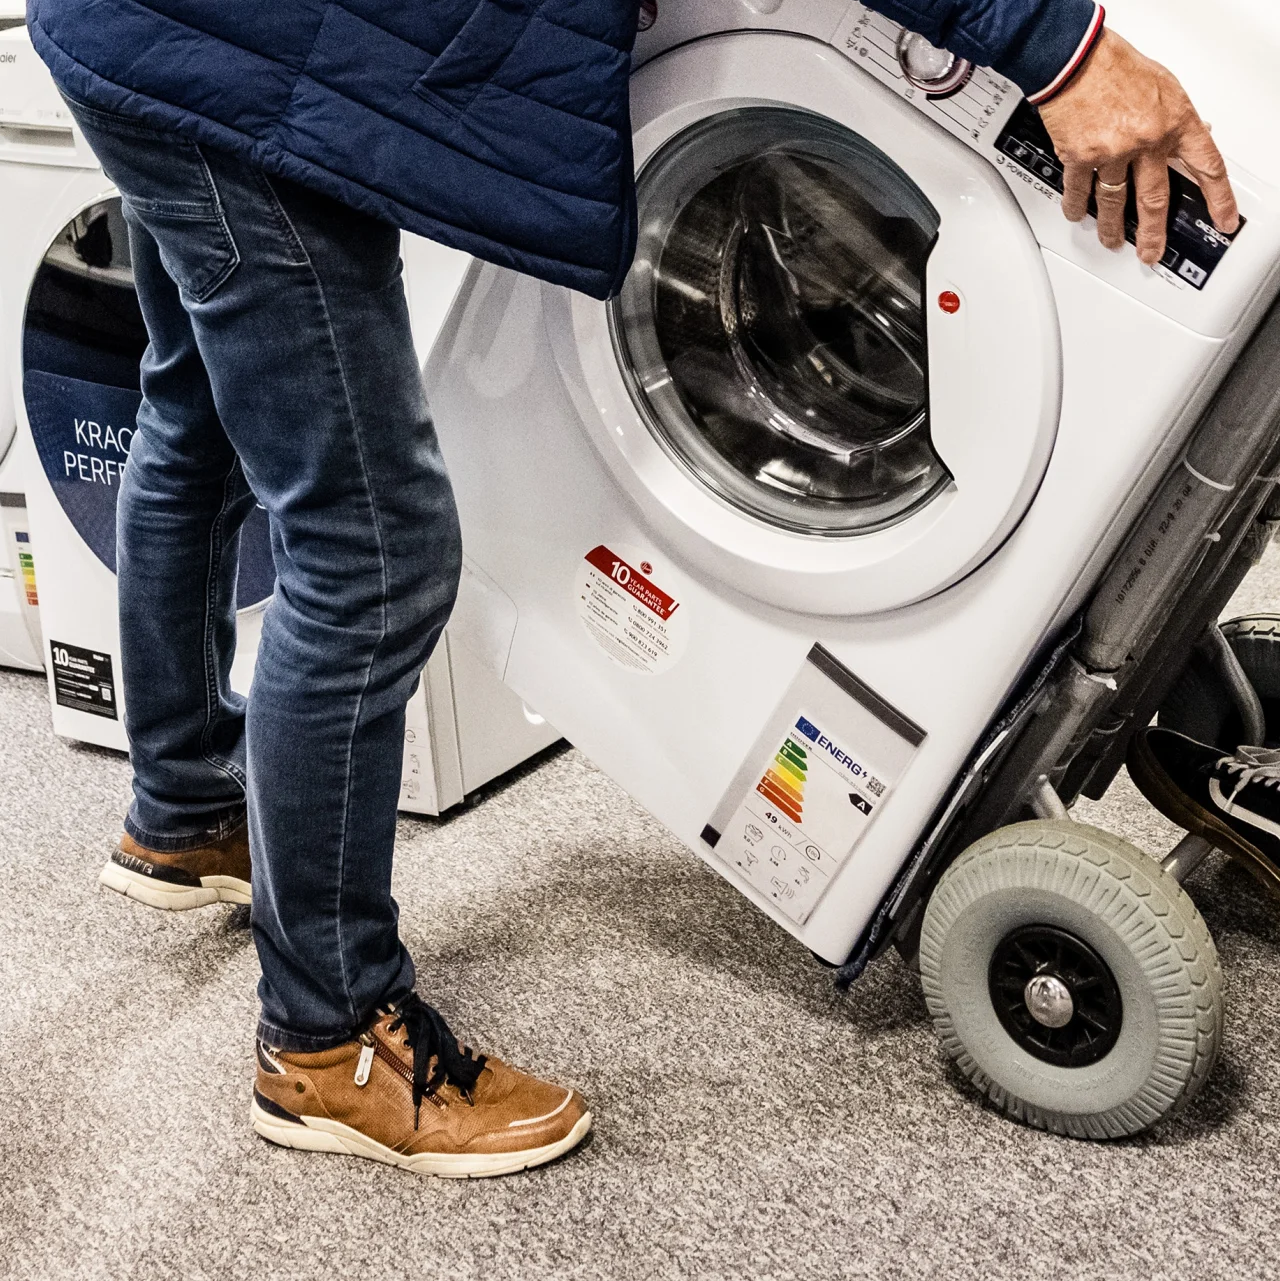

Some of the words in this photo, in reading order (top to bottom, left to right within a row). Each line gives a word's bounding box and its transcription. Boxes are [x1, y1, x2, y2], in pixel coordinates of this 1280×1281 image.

[1006, 161, 1034, 185] POWER
[1033, 182, 1055, 200] CARE
[611, 561, 631, 585] 10
[630, 577, 645, 592] YEAR
[644, 589, 663, 606] PARTS
[627, 583, 665, 616] GUARANTEE
[52, 647, 69, 667] 10
[817, 735, 862, 776] ENERG
[857, 801, 866, 811] A
[765, 811, 778, 824] 49
[778, 824, 793, 839] kWh
